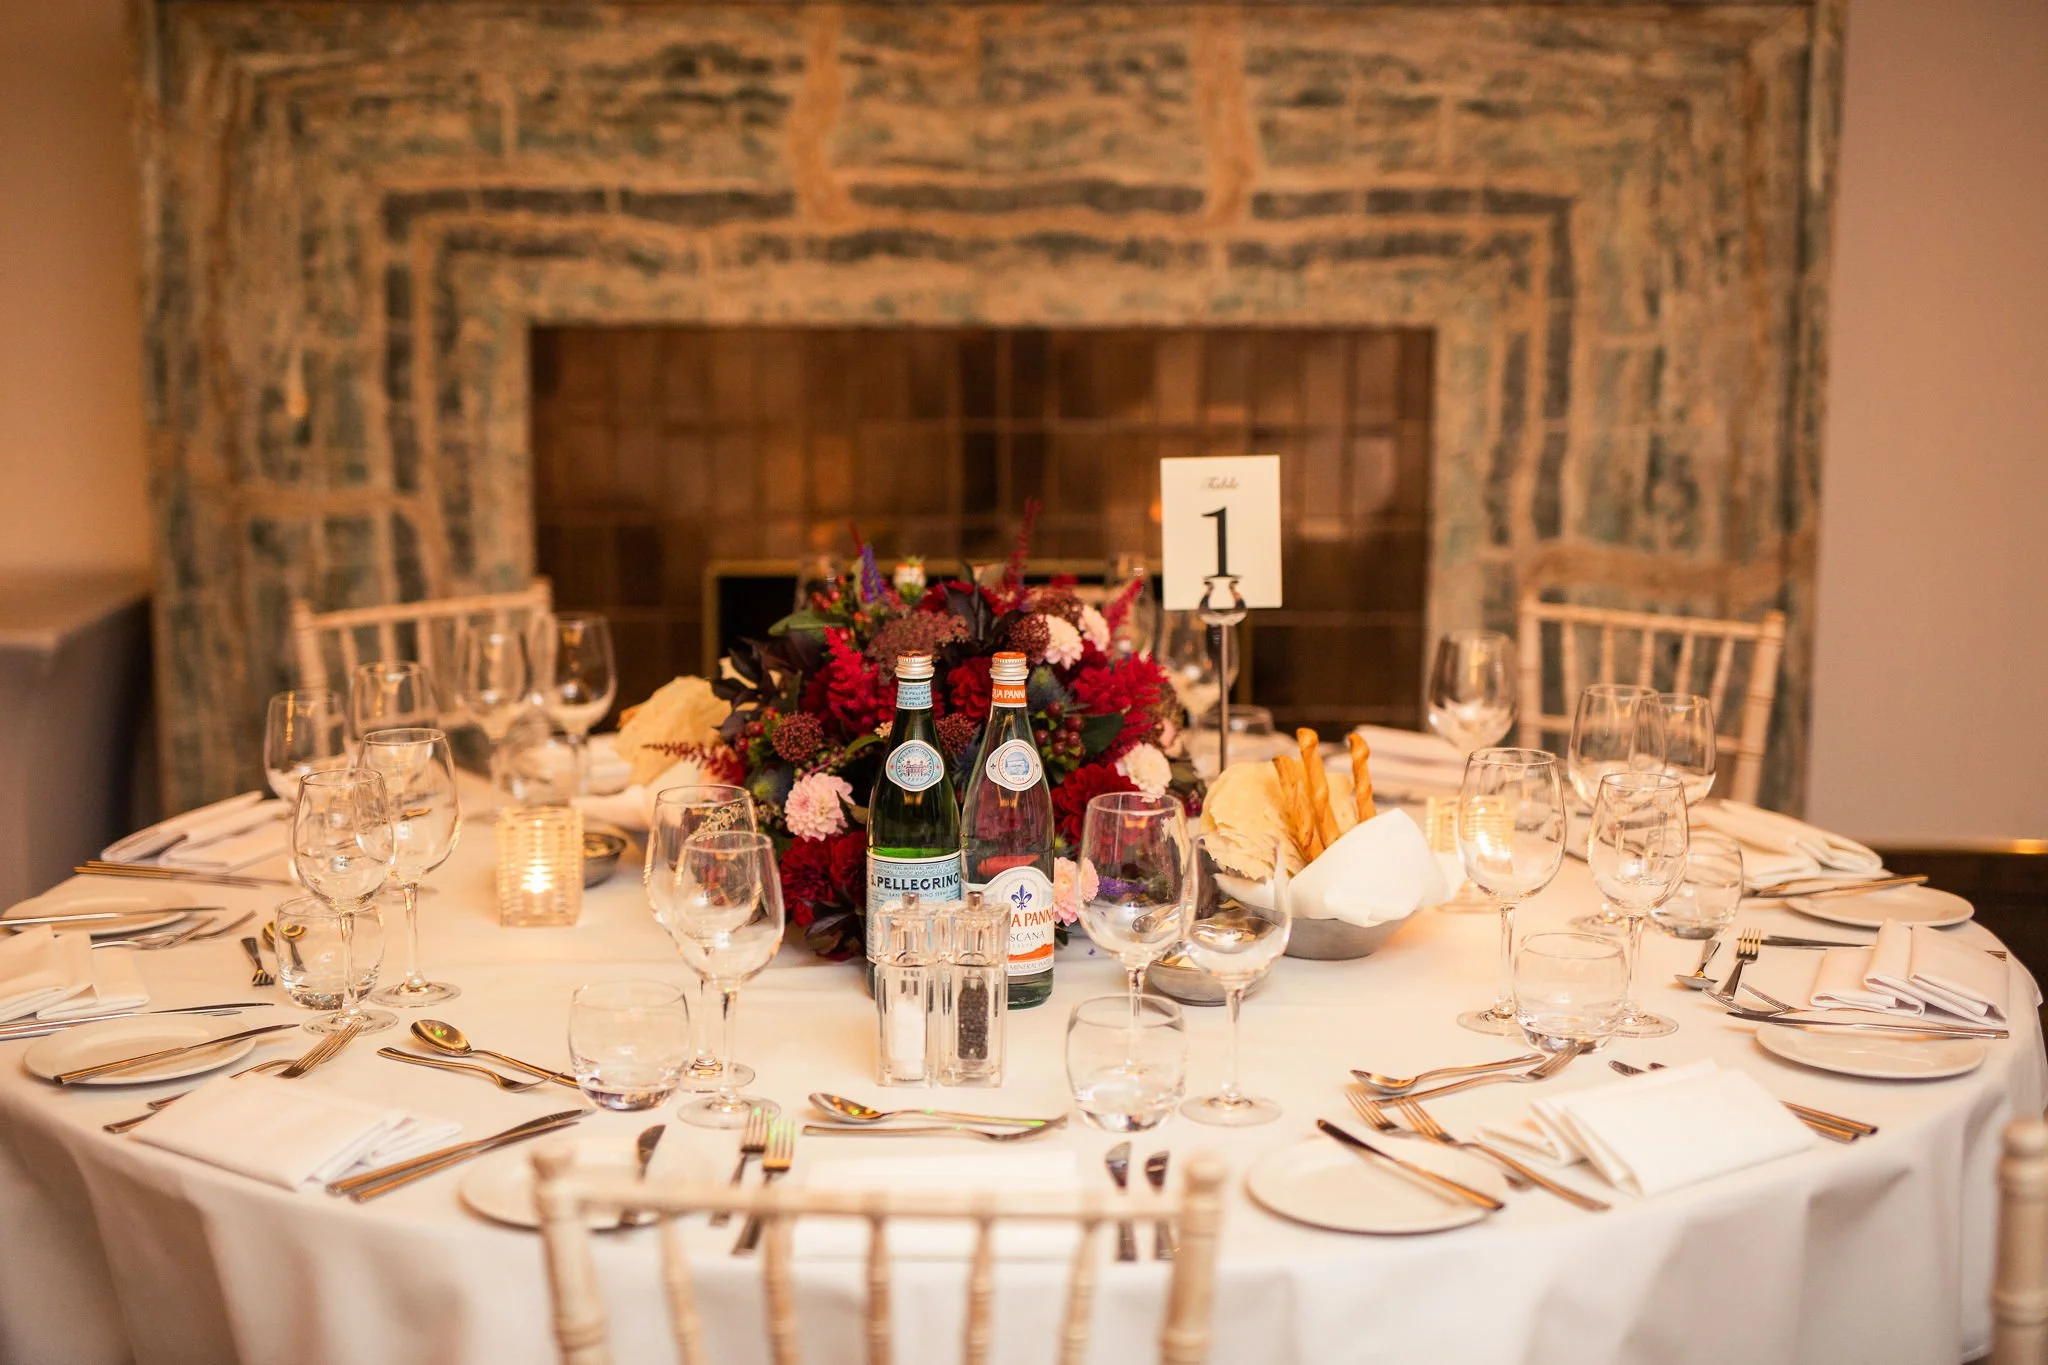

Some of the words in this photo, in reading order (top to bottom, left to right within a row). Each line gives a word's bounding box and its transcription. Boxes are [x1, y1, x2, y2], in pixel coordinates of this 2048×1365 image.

[1202, 506, 1242, 578] 1
[1004, 689, 1026, 699] PANN
[1010, 930, 1045, 942] SCANA
